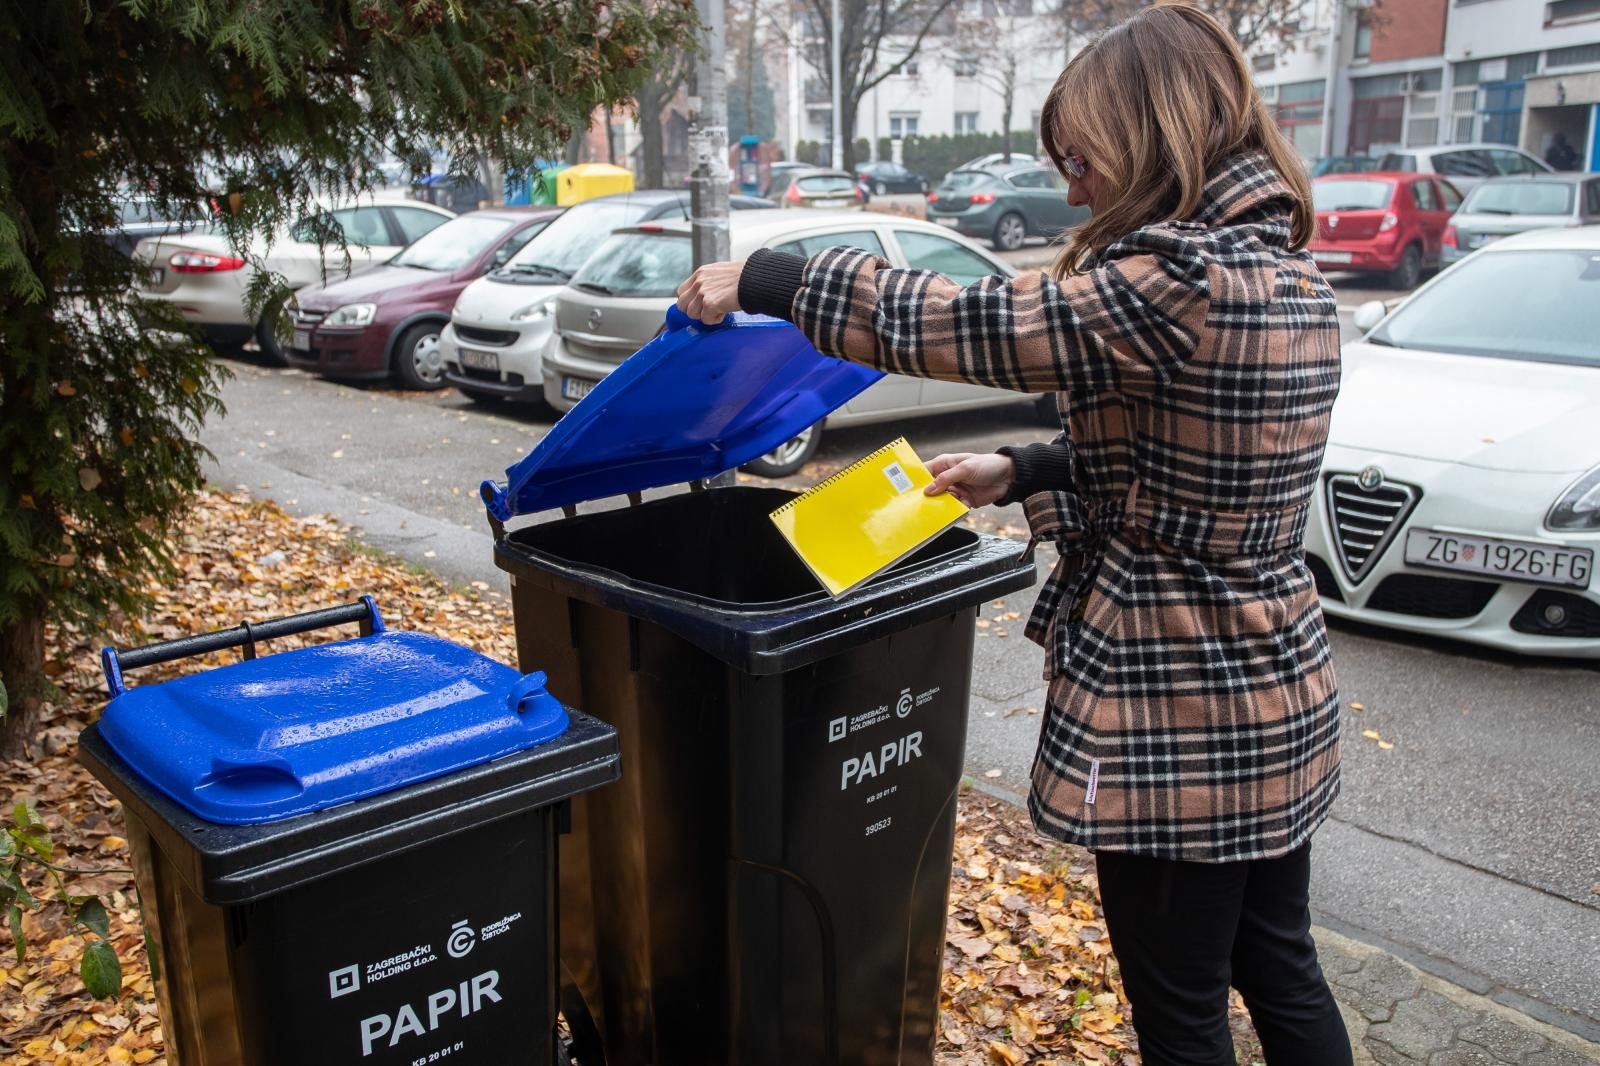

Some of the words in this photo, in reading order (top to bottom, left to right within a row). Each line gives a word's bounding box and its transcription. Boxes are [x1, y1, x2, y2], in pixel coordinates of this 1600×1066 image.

[1426, 536, 1458, 564] ZG
[850, 705, 889, 725] ZAGREBAČKI
[850, 718, 876, 733] HOLDING
[877, 713, 891, 724] d.o.o.
[841, 730, 923, 791] PAPIR
[866, 795, 876, 805] KB
[876, 791, 883, 800] 20
[883, 788, 890, 797] 01
[890, 785, 898, 793] 01
[865, 817, 892, 836] 390523
[481, 912, 522, 935] PODRUŽNICA
[366, 944, 431, 974] ZAGREBAČKI
[367, 961, 412, 984] HOLDING
[413, 954, 438, 967] d.o.o.
[360, 969, 503, 1057] PAPIR
[412, 1056, 427, 1066] KB
[428, 1051, 440, 1062] 20
[441, 1046, 451, 1057] 01
[454, 1040, 464, 1051] 01
